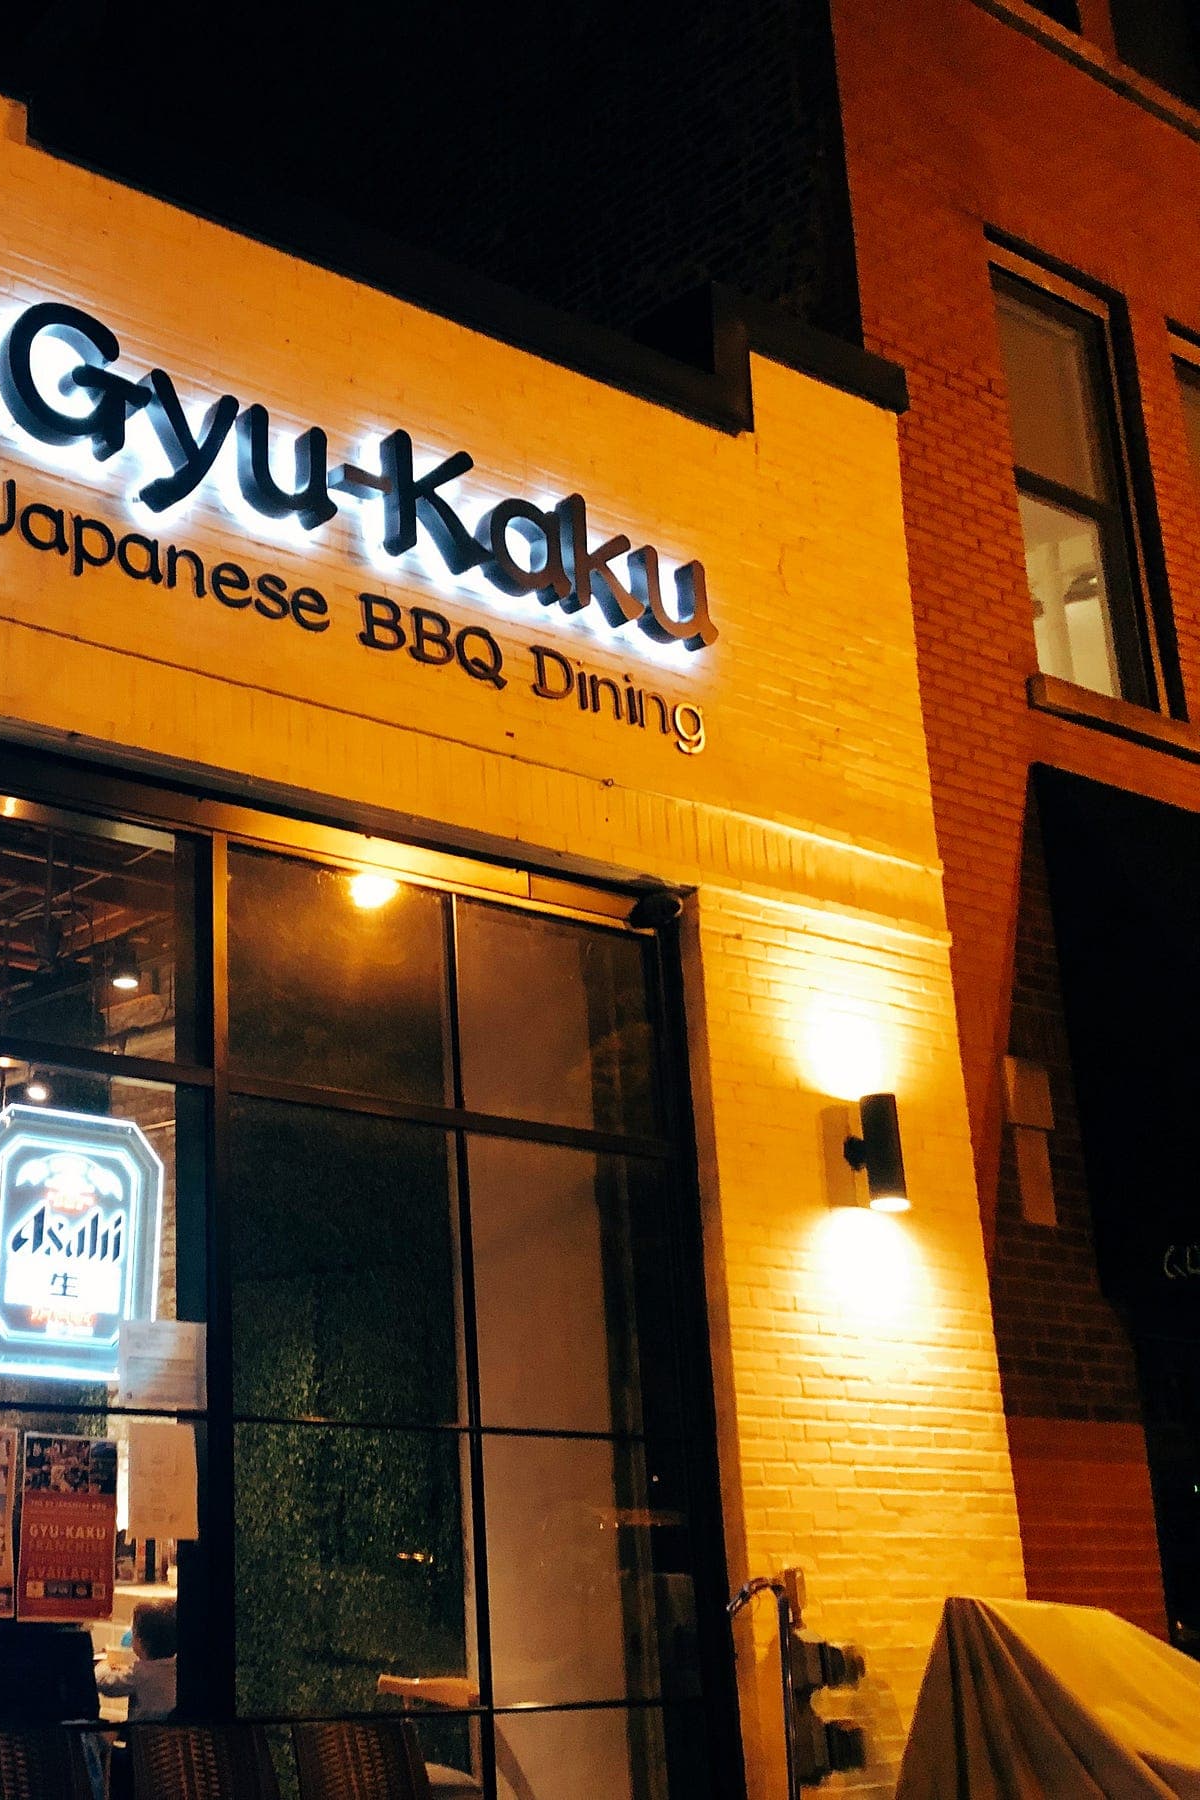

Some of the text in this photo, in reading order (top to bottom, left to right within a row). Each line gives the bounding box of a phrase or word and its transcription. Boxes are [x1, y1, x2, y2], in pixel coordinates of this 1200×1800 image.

[358, 592, 507, 690] BBQ
[529, 645, 706, 754] Dining
[9, 1203, 124, 1264] Asahi
[49, 1271, 79, 1299] 生
[29, 1523, 106, 1541] GYU-KAKU
